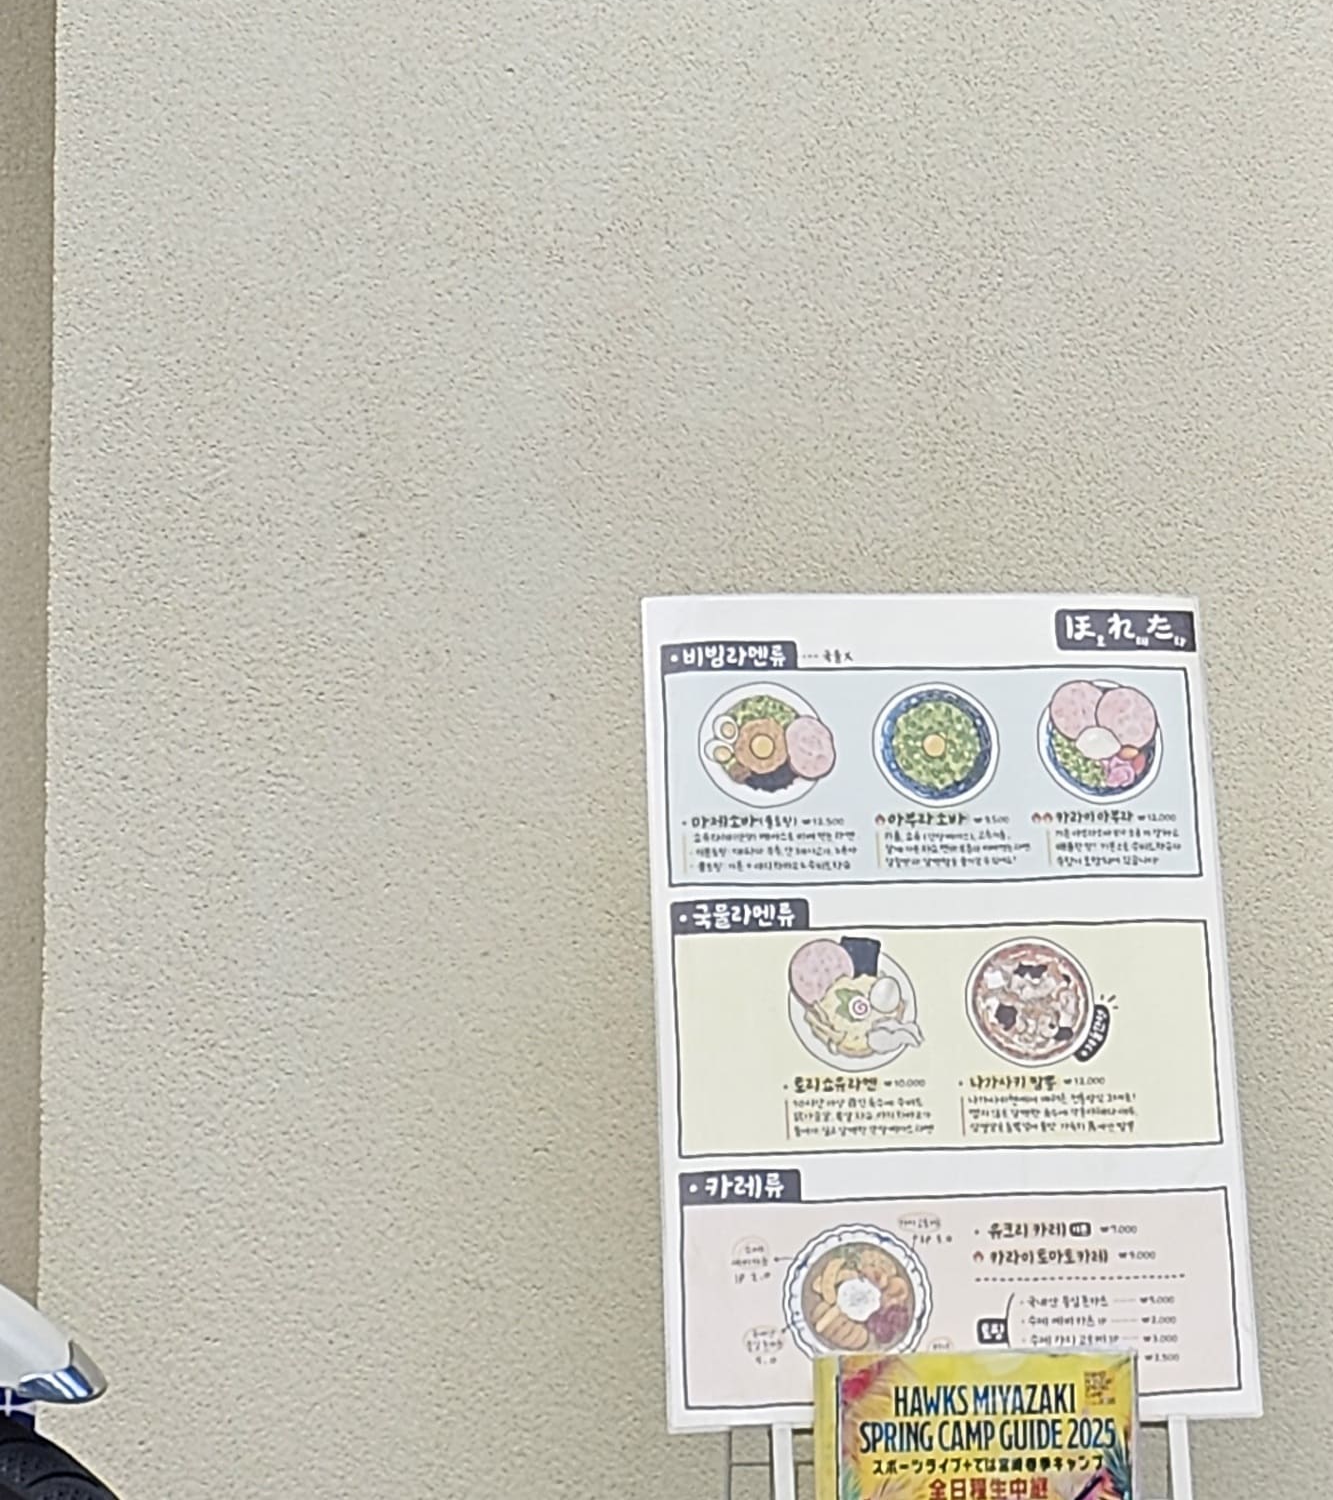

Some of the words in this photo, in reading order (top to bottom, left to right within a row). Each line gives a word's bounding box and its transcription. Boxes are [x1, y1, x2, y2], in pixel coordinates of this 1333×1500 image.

[1065, 612, 1174, 641] ほれた
[682, 644, 786, 668] 비빔라멘류
[692, 902, 796, 930] 국물라멘류
[704, 1172, 784, 1199] 카레류
[894, 1385, 969, 1417] HAWKS
[973, 1383, 1076, 1415] MIYAZAKI
[859, 1421, 934, 1453] SPRING
[938, 1420, 995, 1451] CAMP
[999, 1420, 1063, 1450] GUIDE
[1066, 1418, 1117, 1449] 2025
